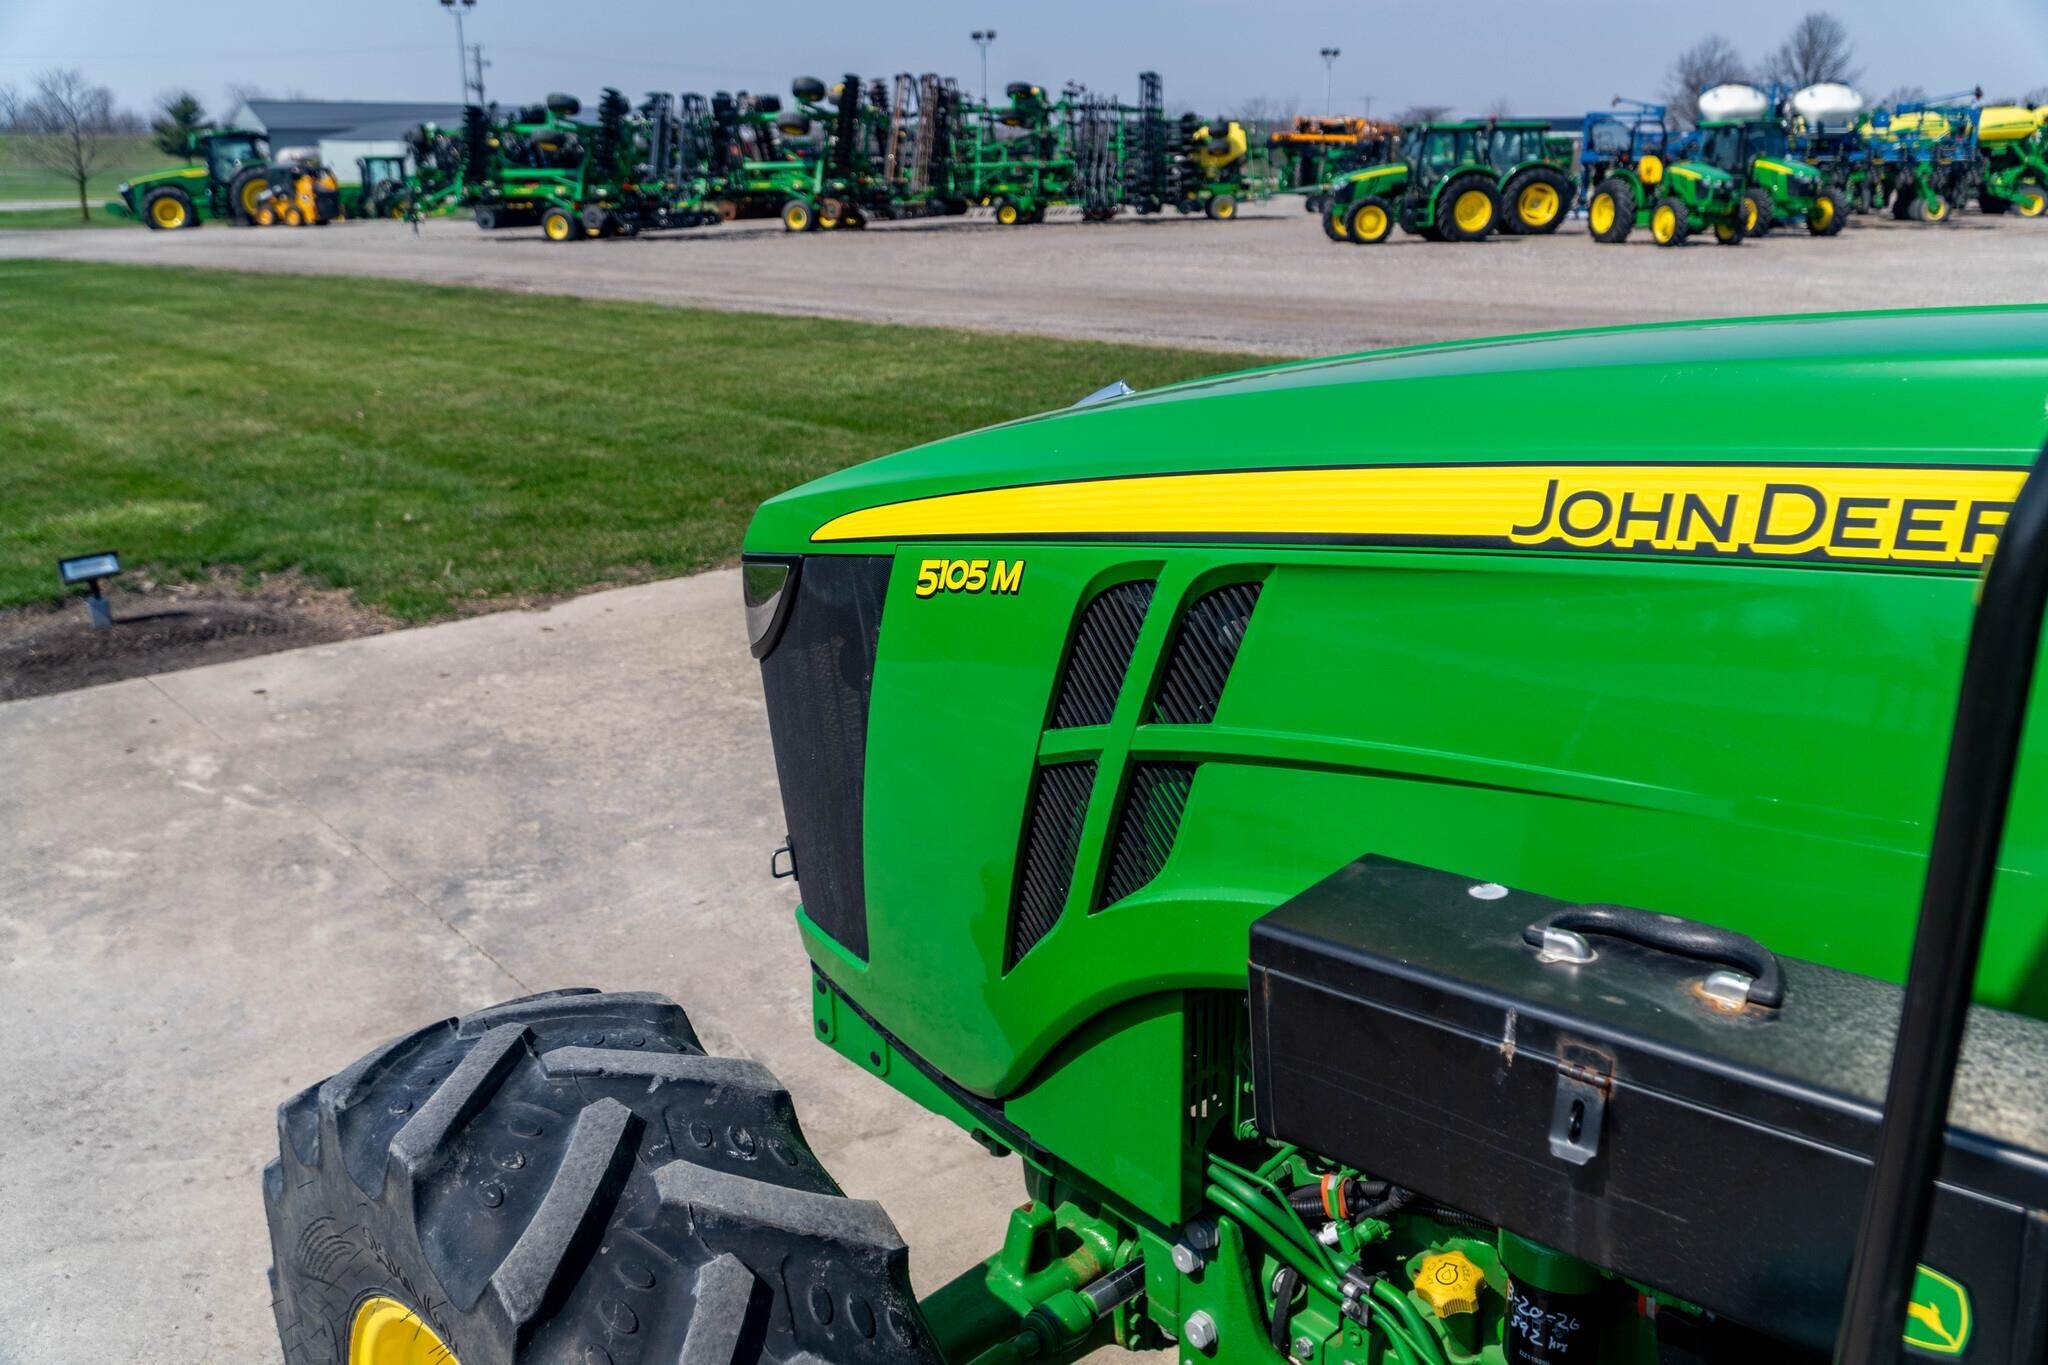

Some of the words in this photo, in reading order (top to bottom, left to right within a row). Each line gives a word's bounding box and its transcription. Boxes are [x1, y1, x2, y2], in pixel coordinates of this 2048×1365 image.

[1510, 479, 1739, 546] JOHN
[915, 559, 989, 598] 5105
[990, 560, 1025, 595] M
